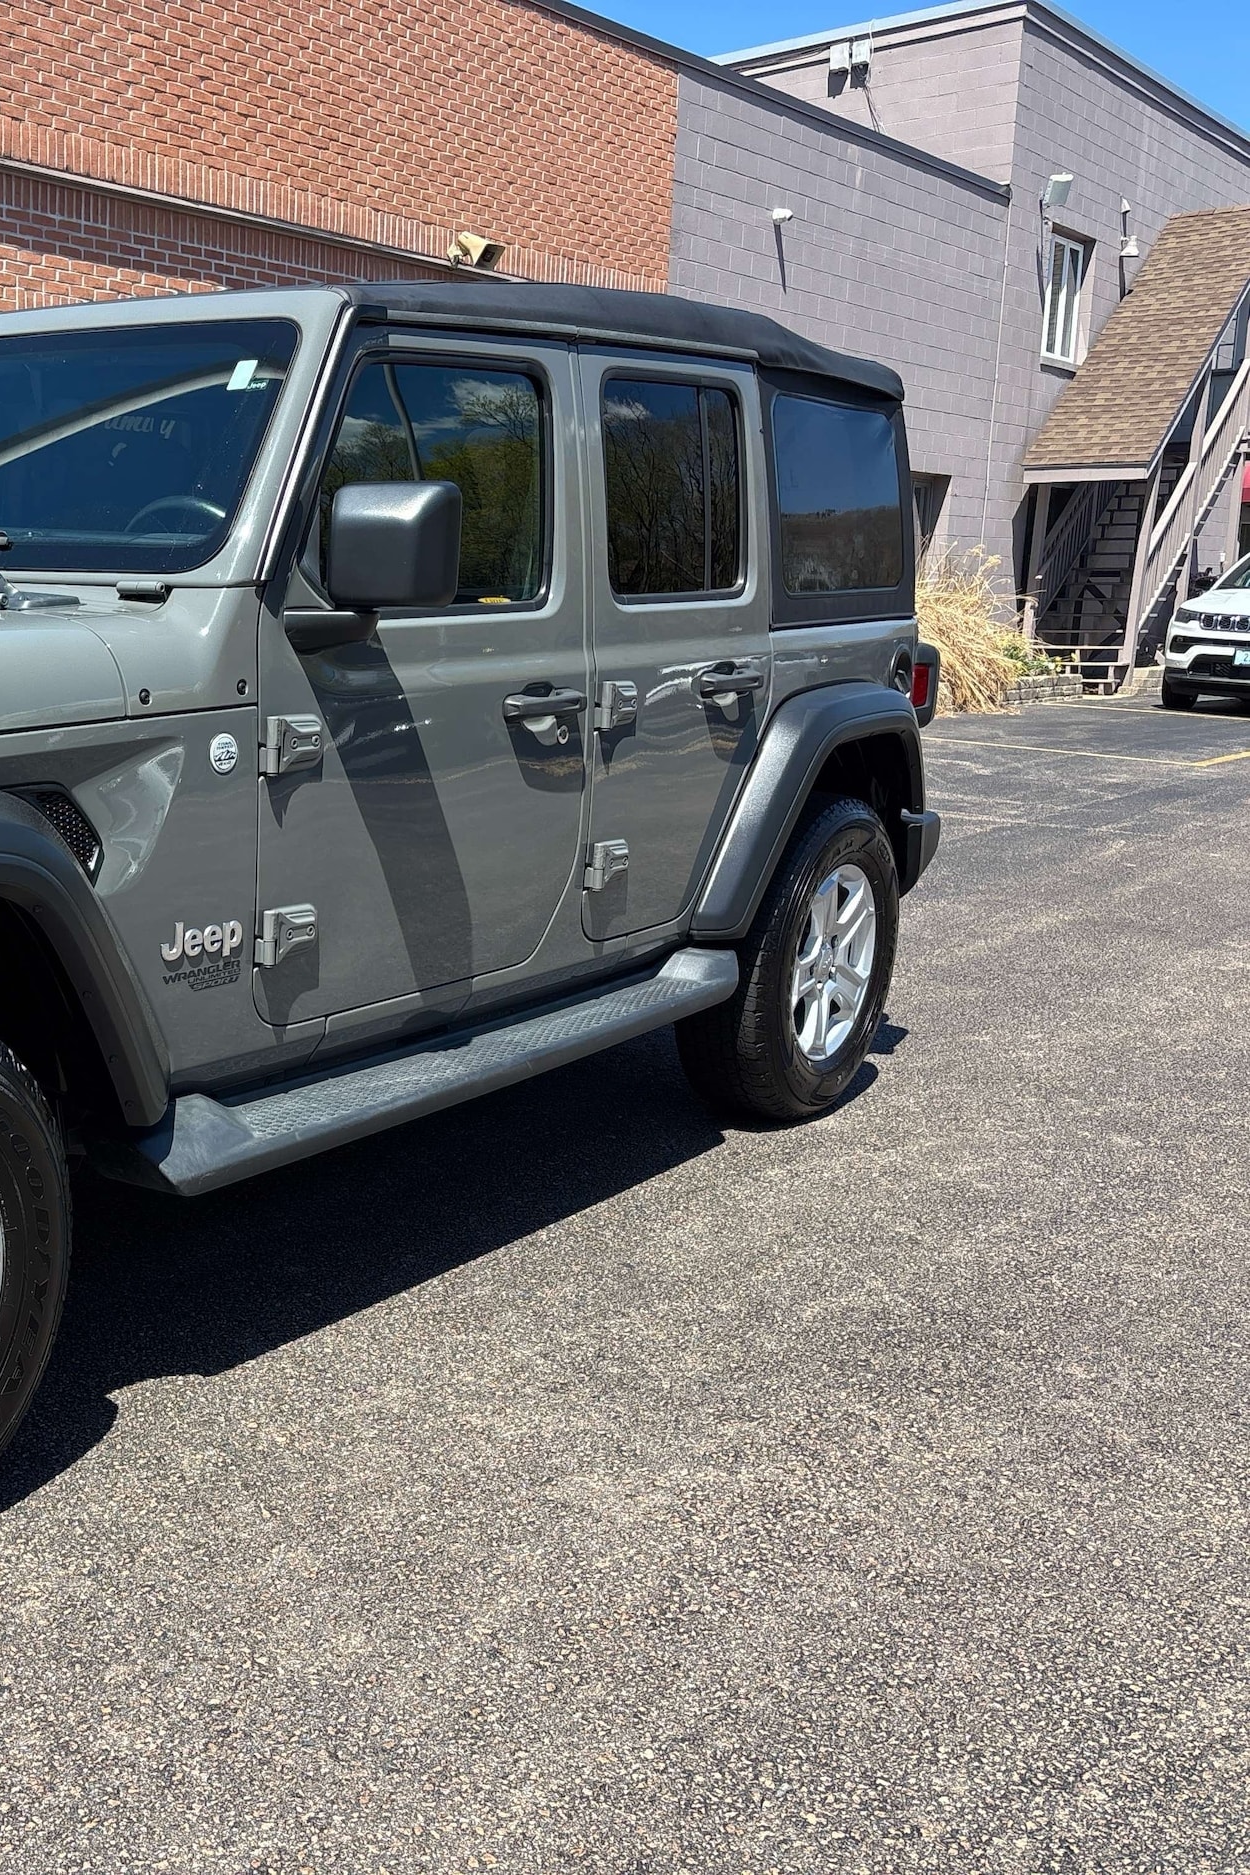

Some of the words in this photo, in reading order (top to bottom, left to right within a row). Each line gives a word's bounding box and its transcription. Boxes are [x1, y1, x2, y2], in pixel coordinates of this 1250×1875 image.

[160, 920, 243, 962] Jeep
[162, 960, 241, 985] WRANGLER
[188, 968, 241, 984] UNLIMITED
